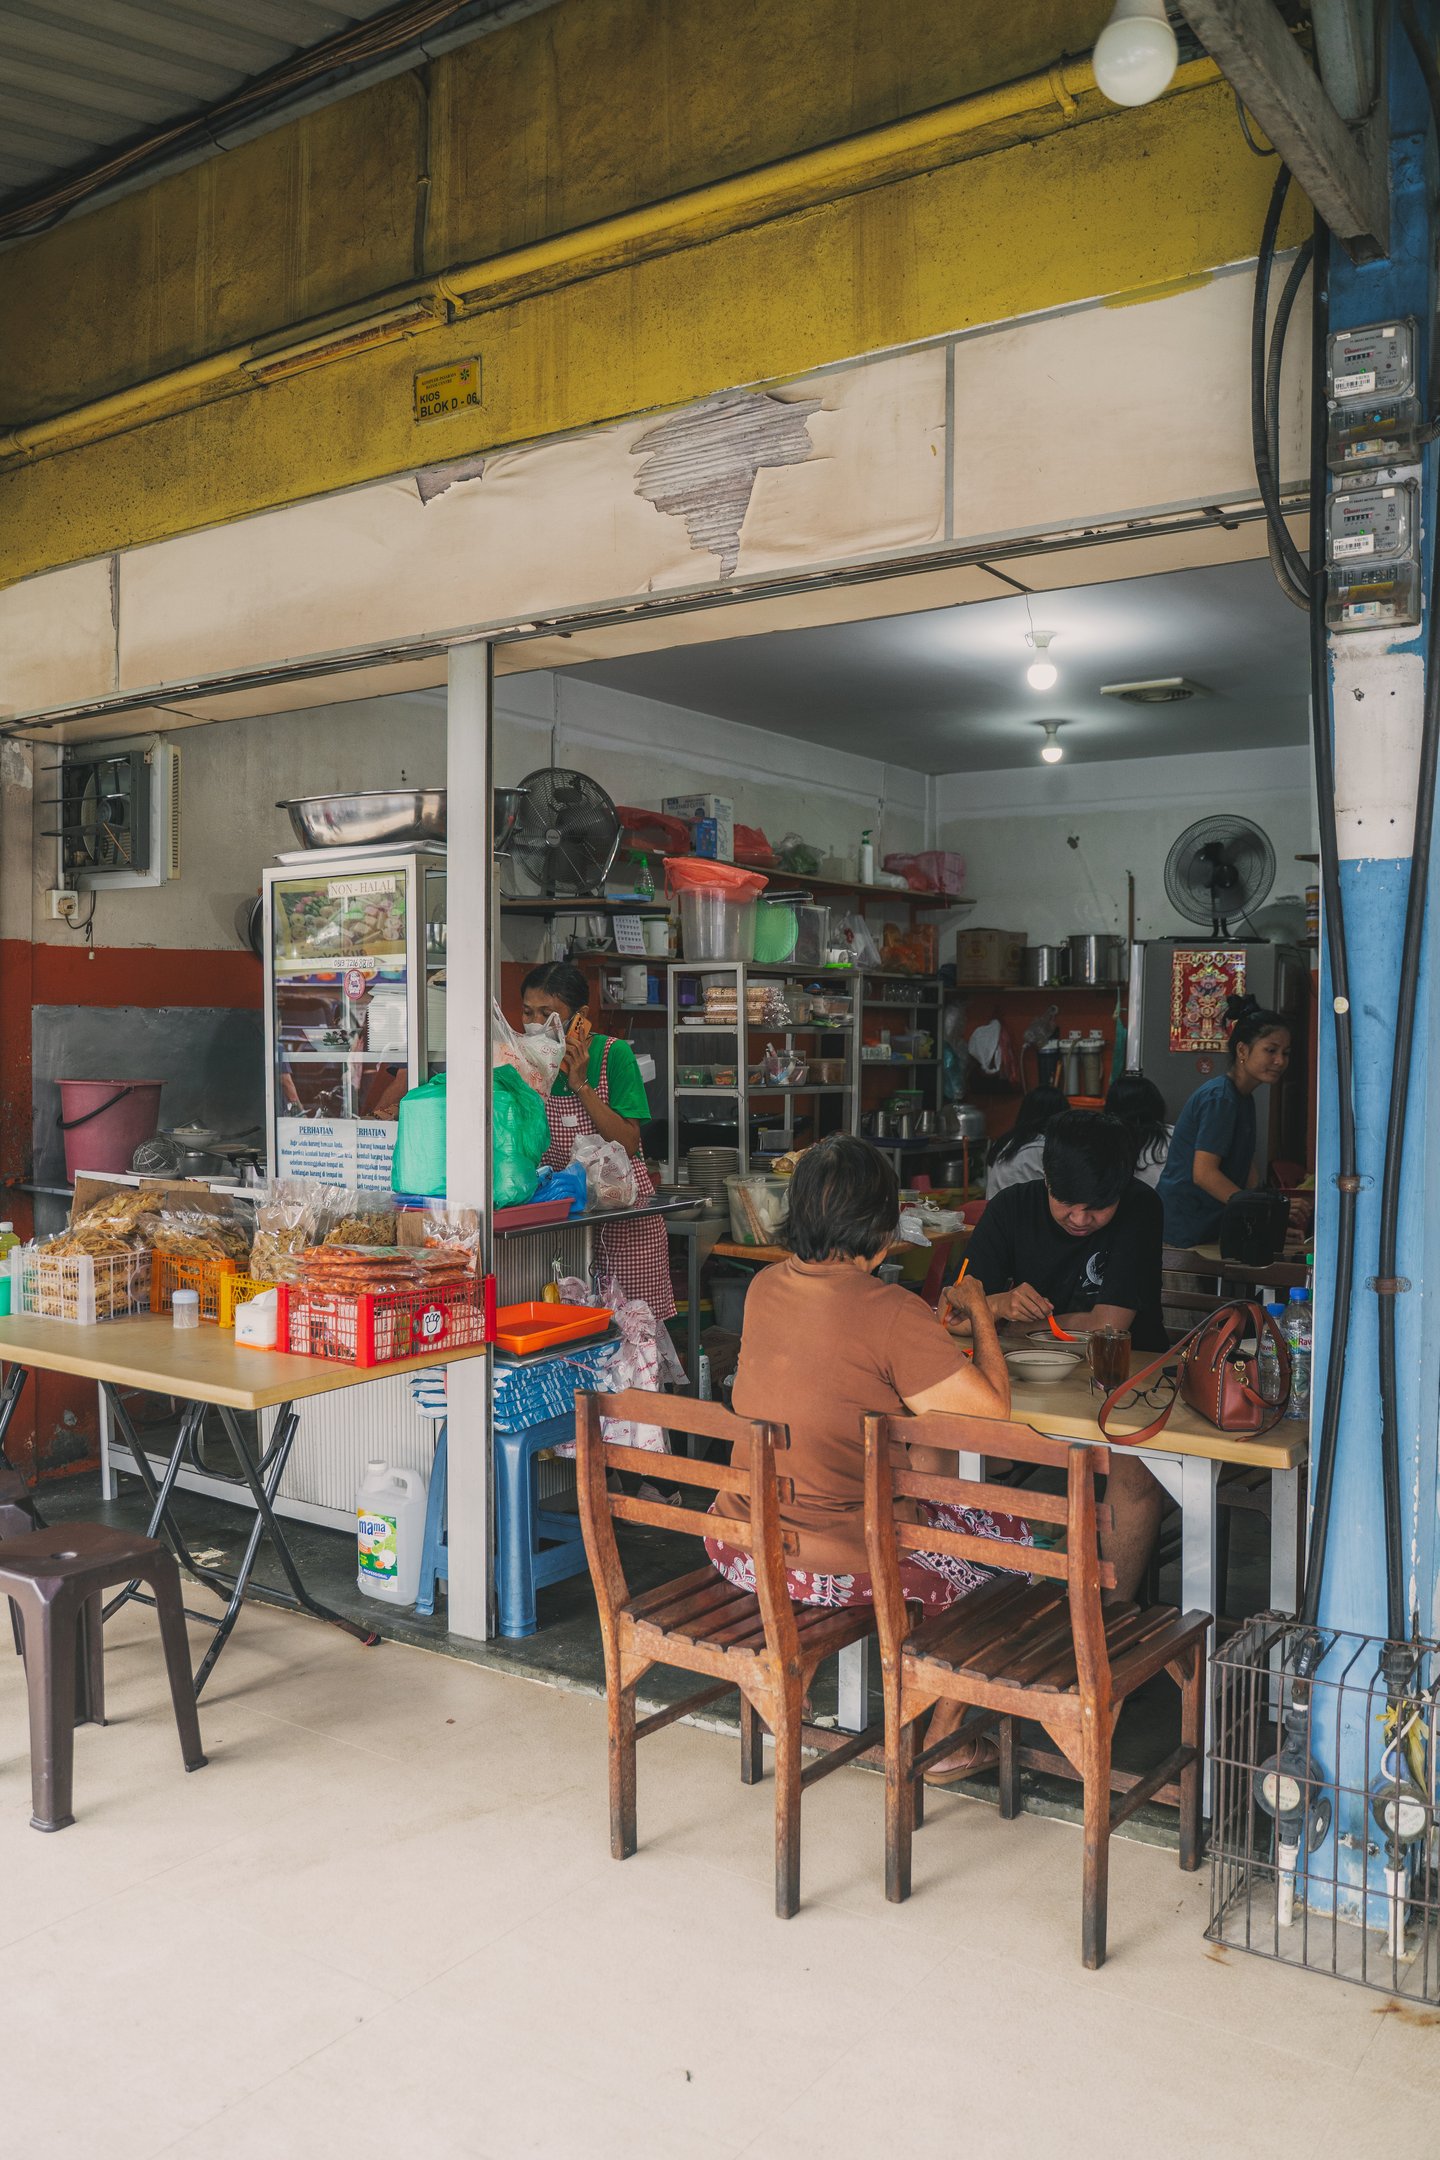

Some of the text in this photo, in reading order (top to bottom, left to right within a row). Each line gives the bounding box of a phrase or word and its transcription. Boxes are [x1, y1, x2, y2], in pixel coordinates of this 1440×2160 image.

[420, 391, 440, 404] KIOS
[420, 400, 448, 418] BLOK
[452, 398, 458, 409] D
[466, 392, 477, 404] 06
[331, 884, 352, 896] NON
[360, 880, 393, 893] HALAL
[300, 1126, 334, 1135] PERHATIAN
[356, 1128, 386, 1137] ERHATIAN
[359, 1520, 386, 1536] mama
